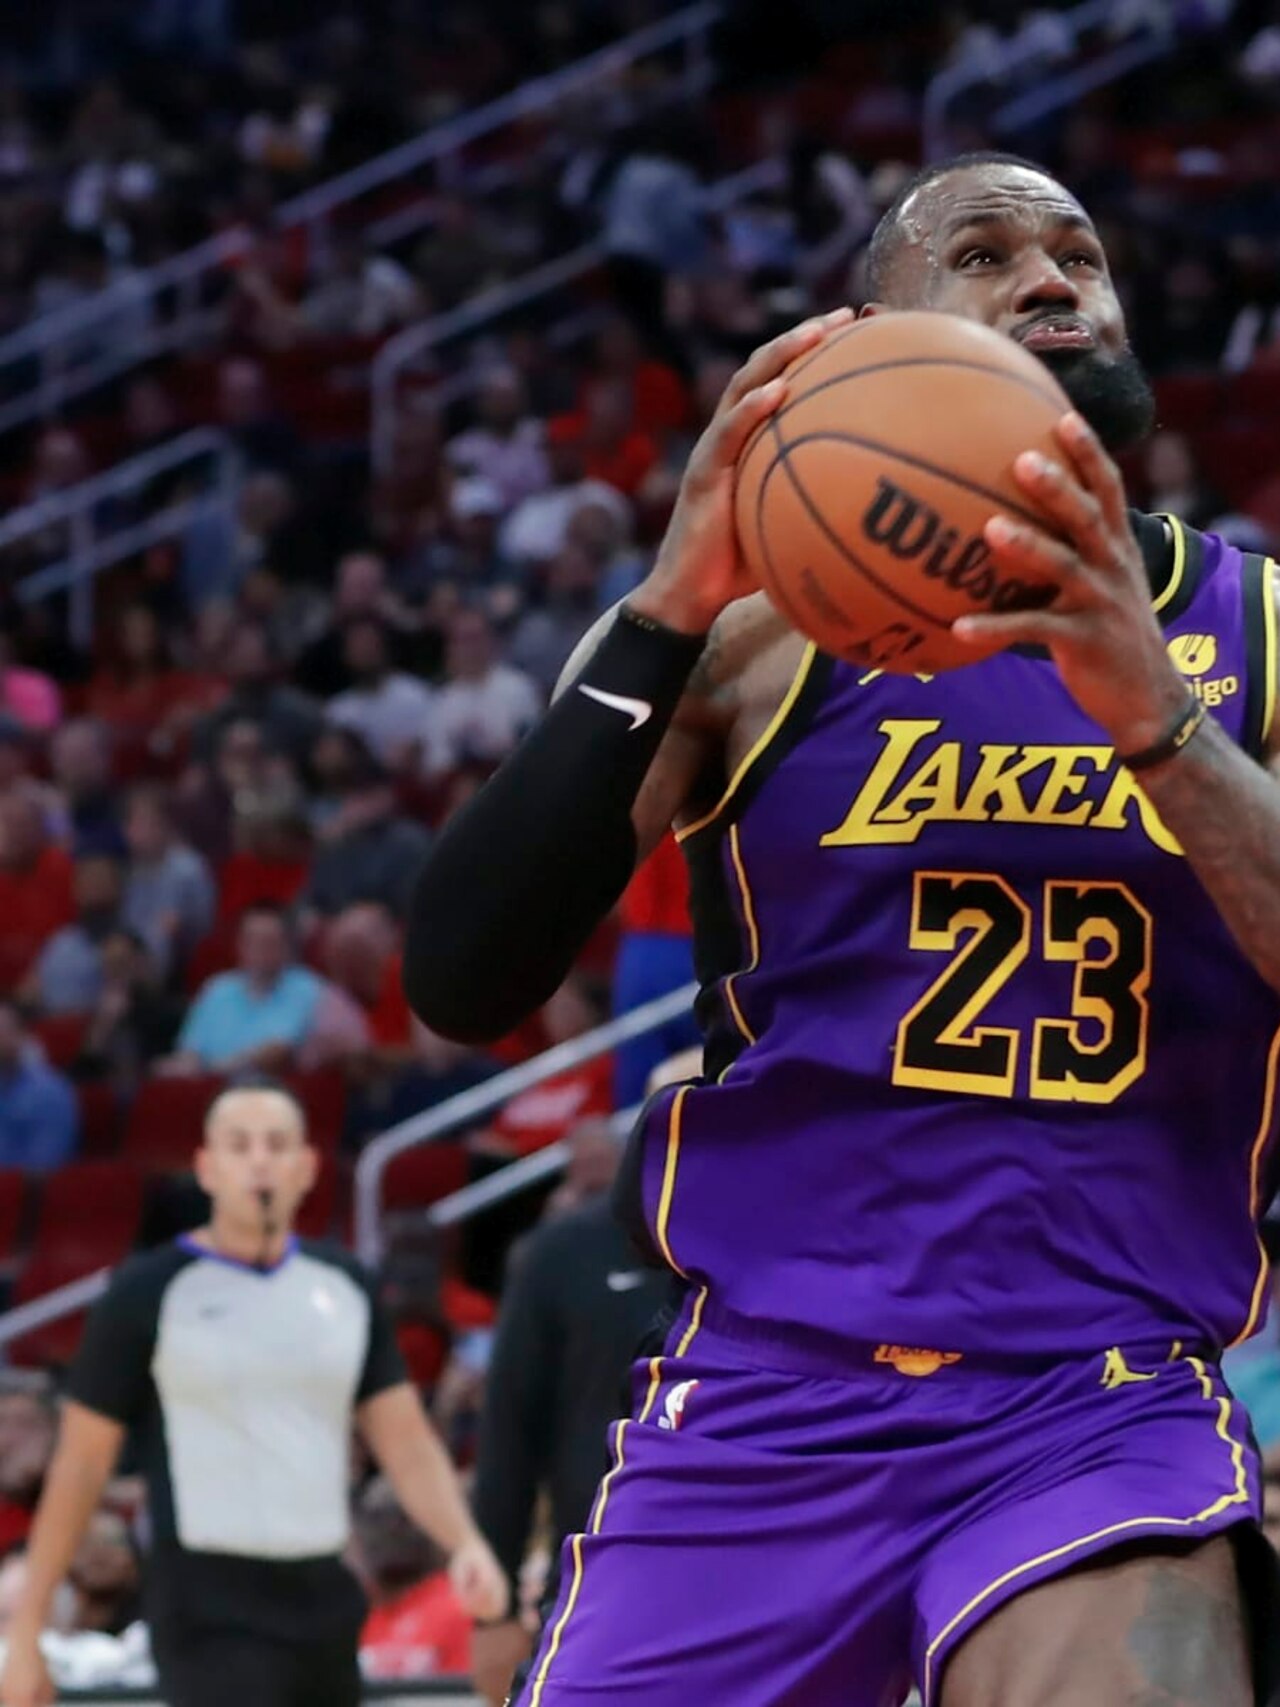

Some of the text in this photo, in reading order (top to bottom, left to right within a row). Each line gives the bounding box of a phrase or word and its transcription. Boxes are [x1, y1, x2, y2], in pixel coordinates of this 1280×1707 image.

[861, 475, 1055, 613] Wilso
[818, 719, 1186, 857] LAKER
[891, 870, 1152, 1104] 23
